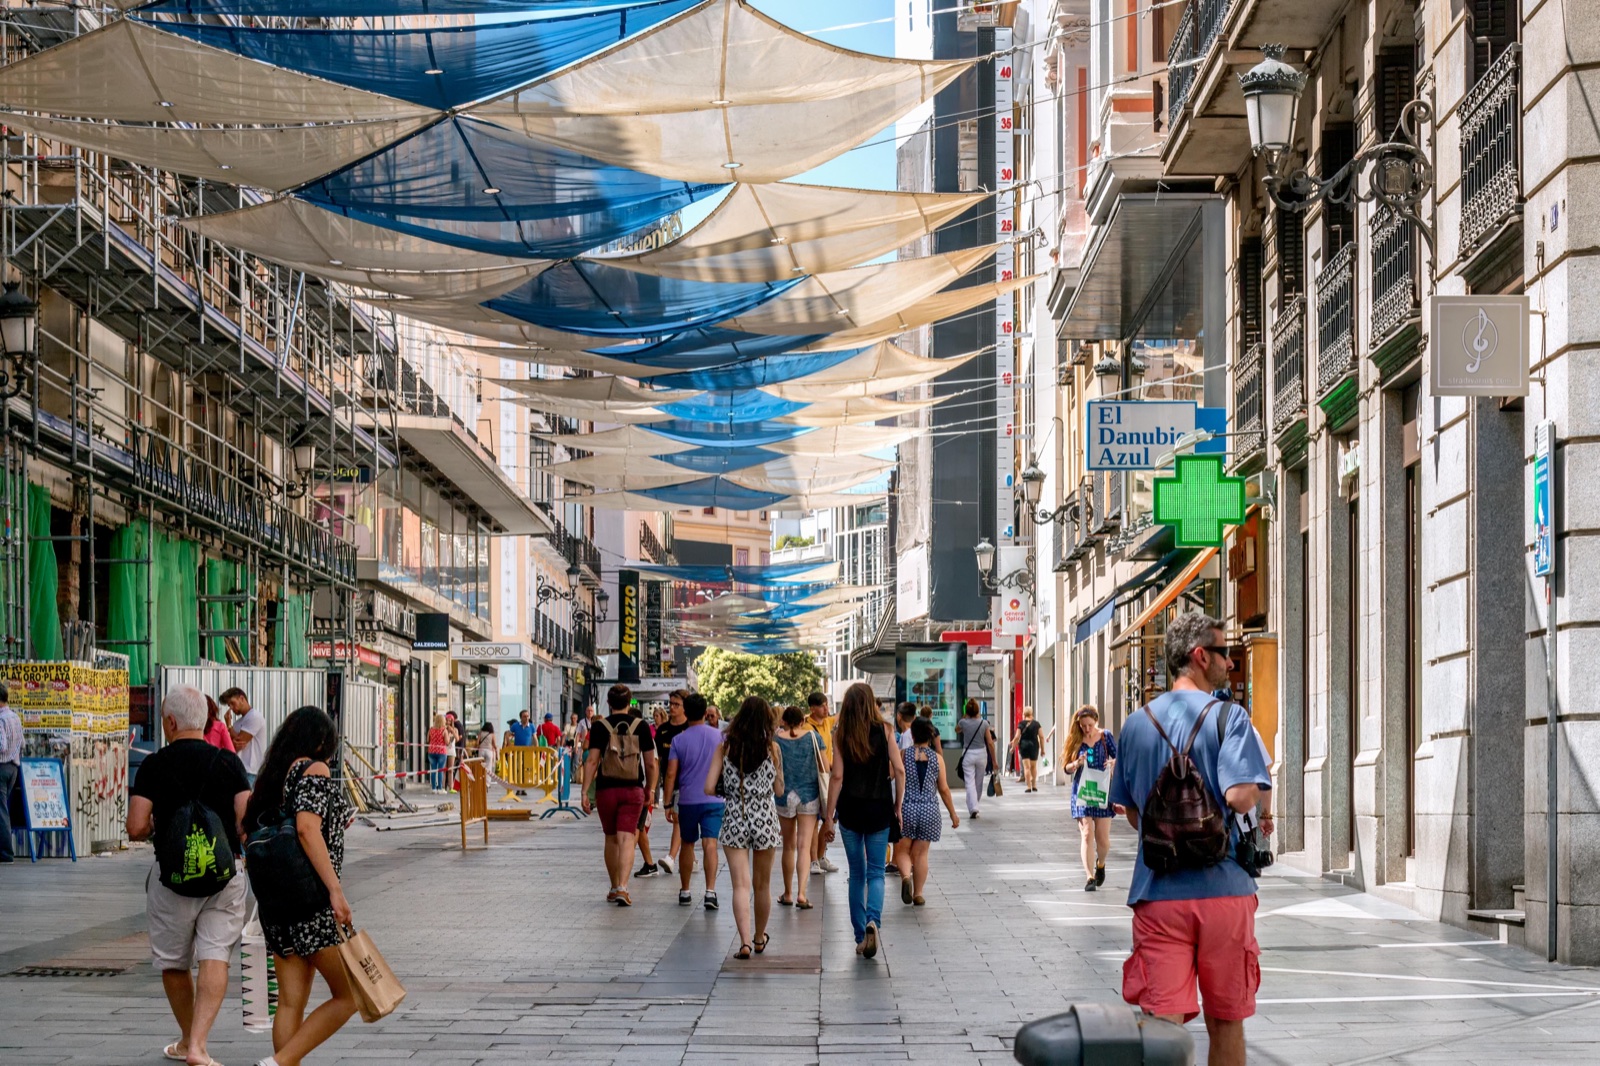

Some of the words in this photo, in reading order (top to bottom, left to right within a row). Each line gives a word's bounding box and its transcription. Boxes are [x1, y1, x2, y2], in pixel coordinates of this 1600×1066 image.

[1000, 67, 1011, 78] 40
[1001, 118, 1011, 129] 35
[1001, 169, 1012, 180] 30
[1001, 220, 1012, 231] 25
[1001, 271, 1012, 281] 20
[1002, 322, 1012, 333] 15
[1002, 373, 1012, 385] 10
[1098, 406, 1122, 424] El
[1006, 424, 1012, 435] 5
[1098, 447, 1149, 465] Azul
[1006, 475, 1012, 486] 0
[1004, 526, 1013, 537] -5
[621, 585, 636, 664] Atrezzo
[461, 646, 510, 656] MISSORO
